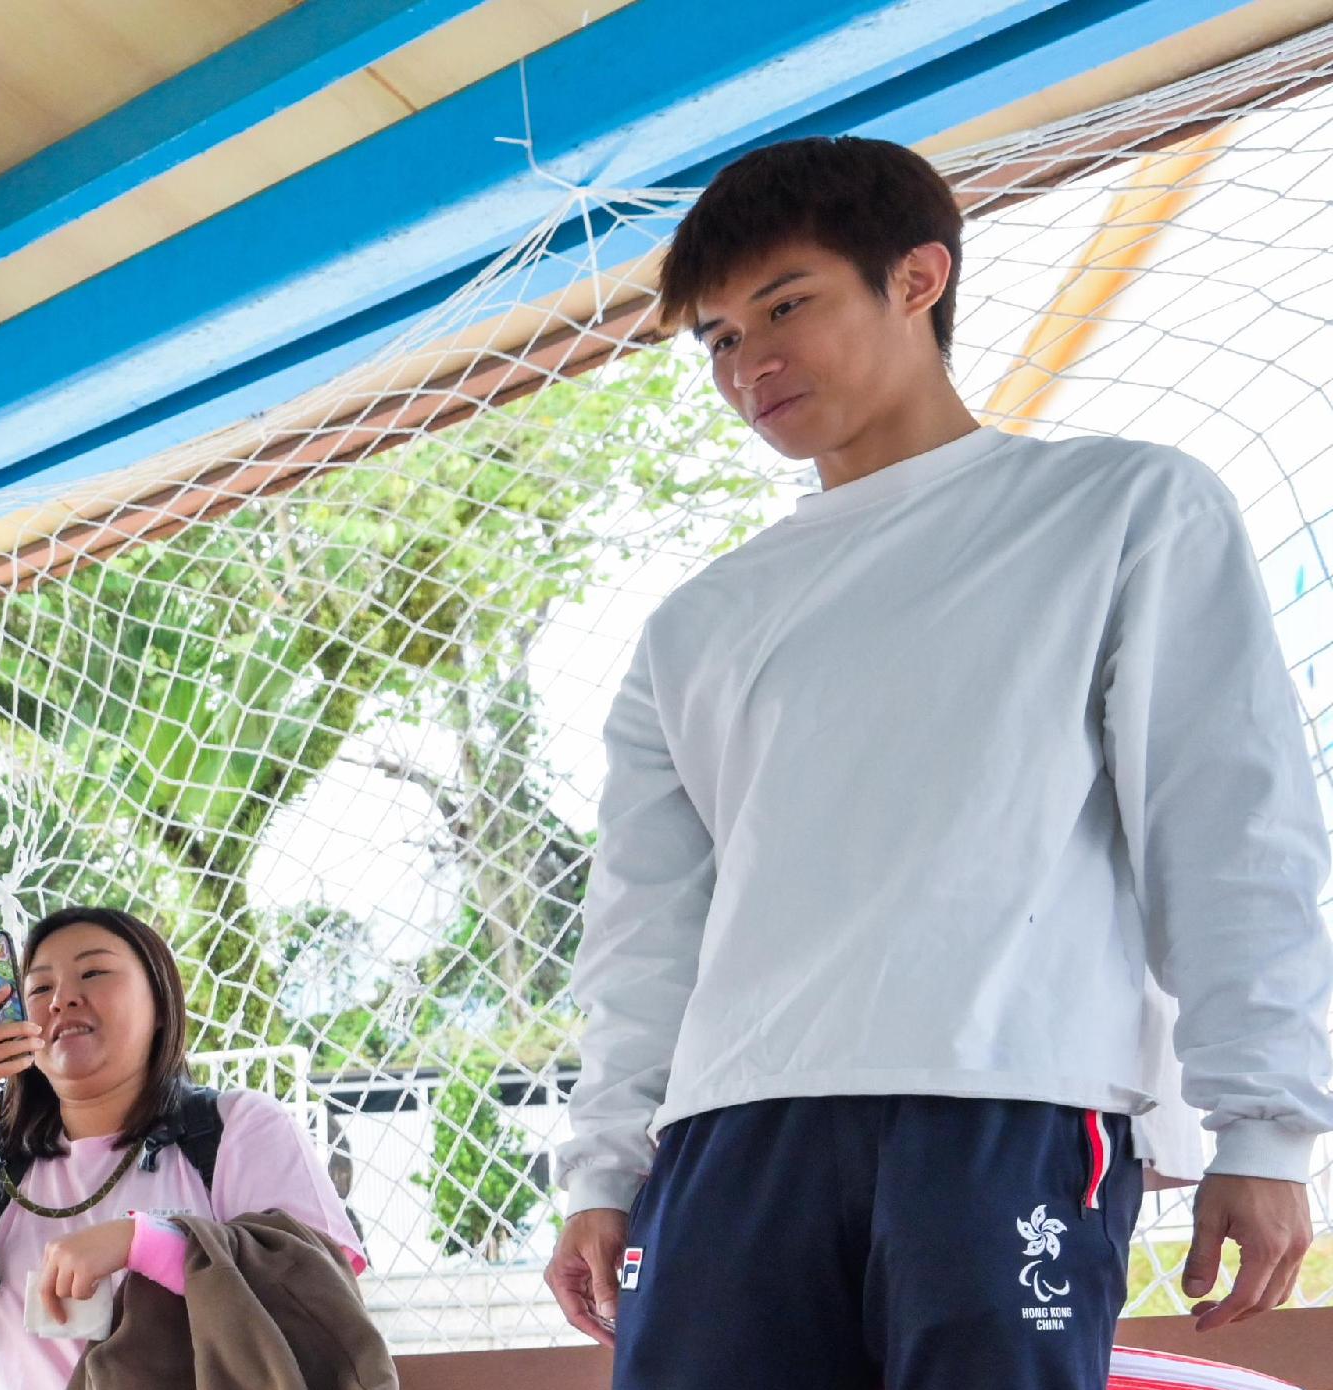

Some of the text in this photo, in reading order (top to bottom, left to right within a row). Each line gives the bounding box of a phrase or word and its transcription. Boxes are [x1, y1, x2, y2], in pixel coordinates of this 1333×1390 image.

[1022, 1307, 1072, 1318] HONG KONG
[1036, 1319, 1064, 1330] CHINA
